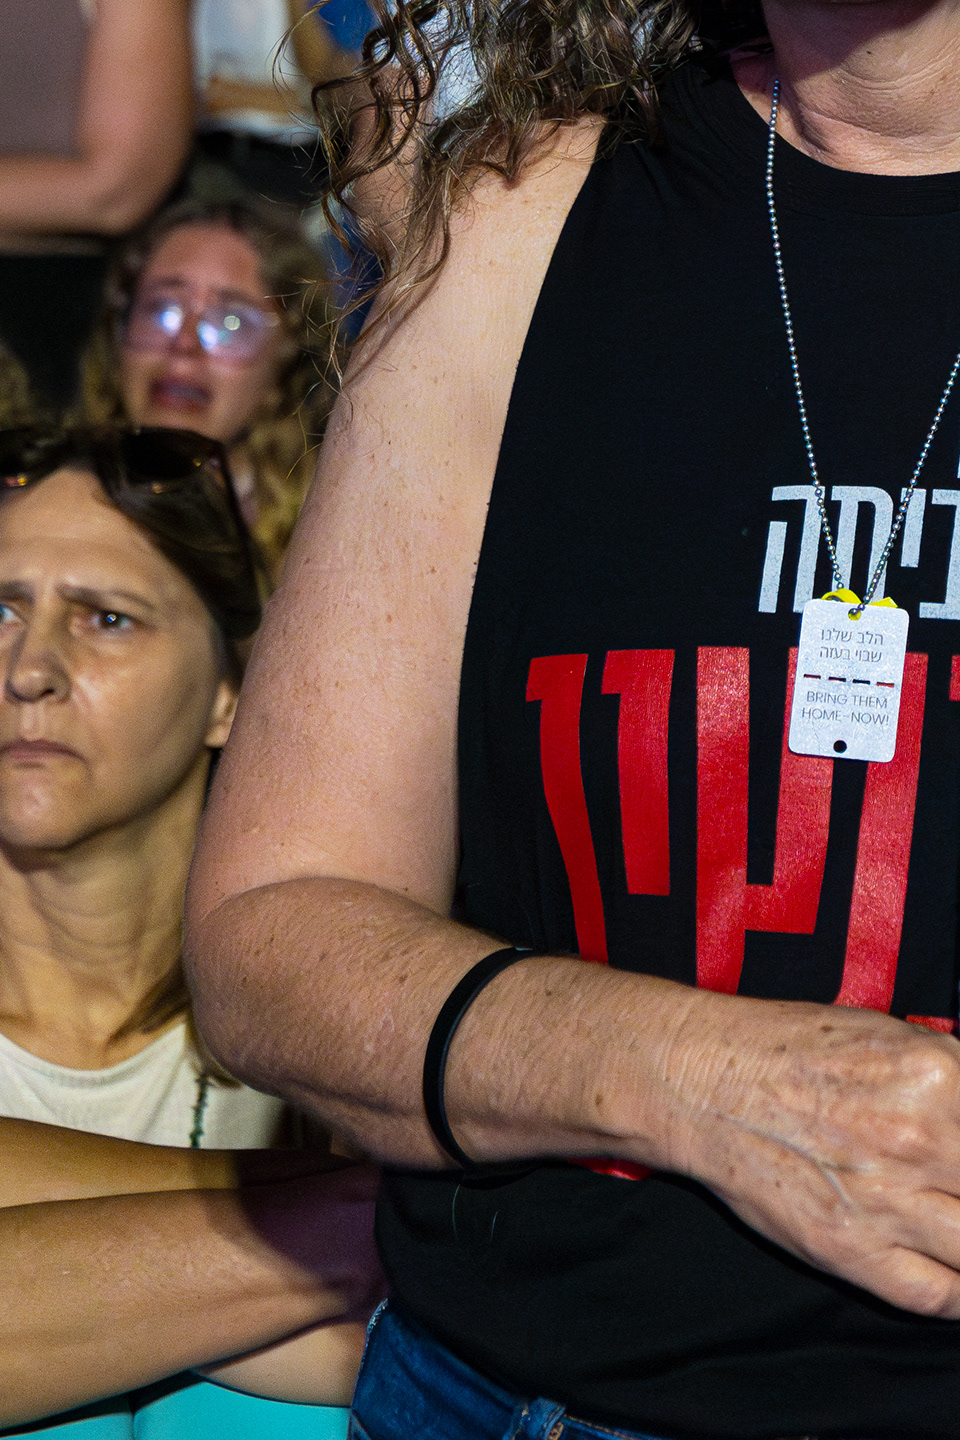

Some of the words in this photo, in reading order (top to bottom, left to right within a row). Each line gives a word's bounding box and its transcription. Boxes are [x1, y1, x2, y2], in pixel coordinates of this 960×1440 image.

[821, 627, 852, 643] שלנו
[856, 630, 884, 646] הלב
[819, 645, 851, 661] בעזה
[855, 648, 882, 663] שבוי
[806, 690, 848, 705] BRING
[851, 694, 888, 709] THEM
